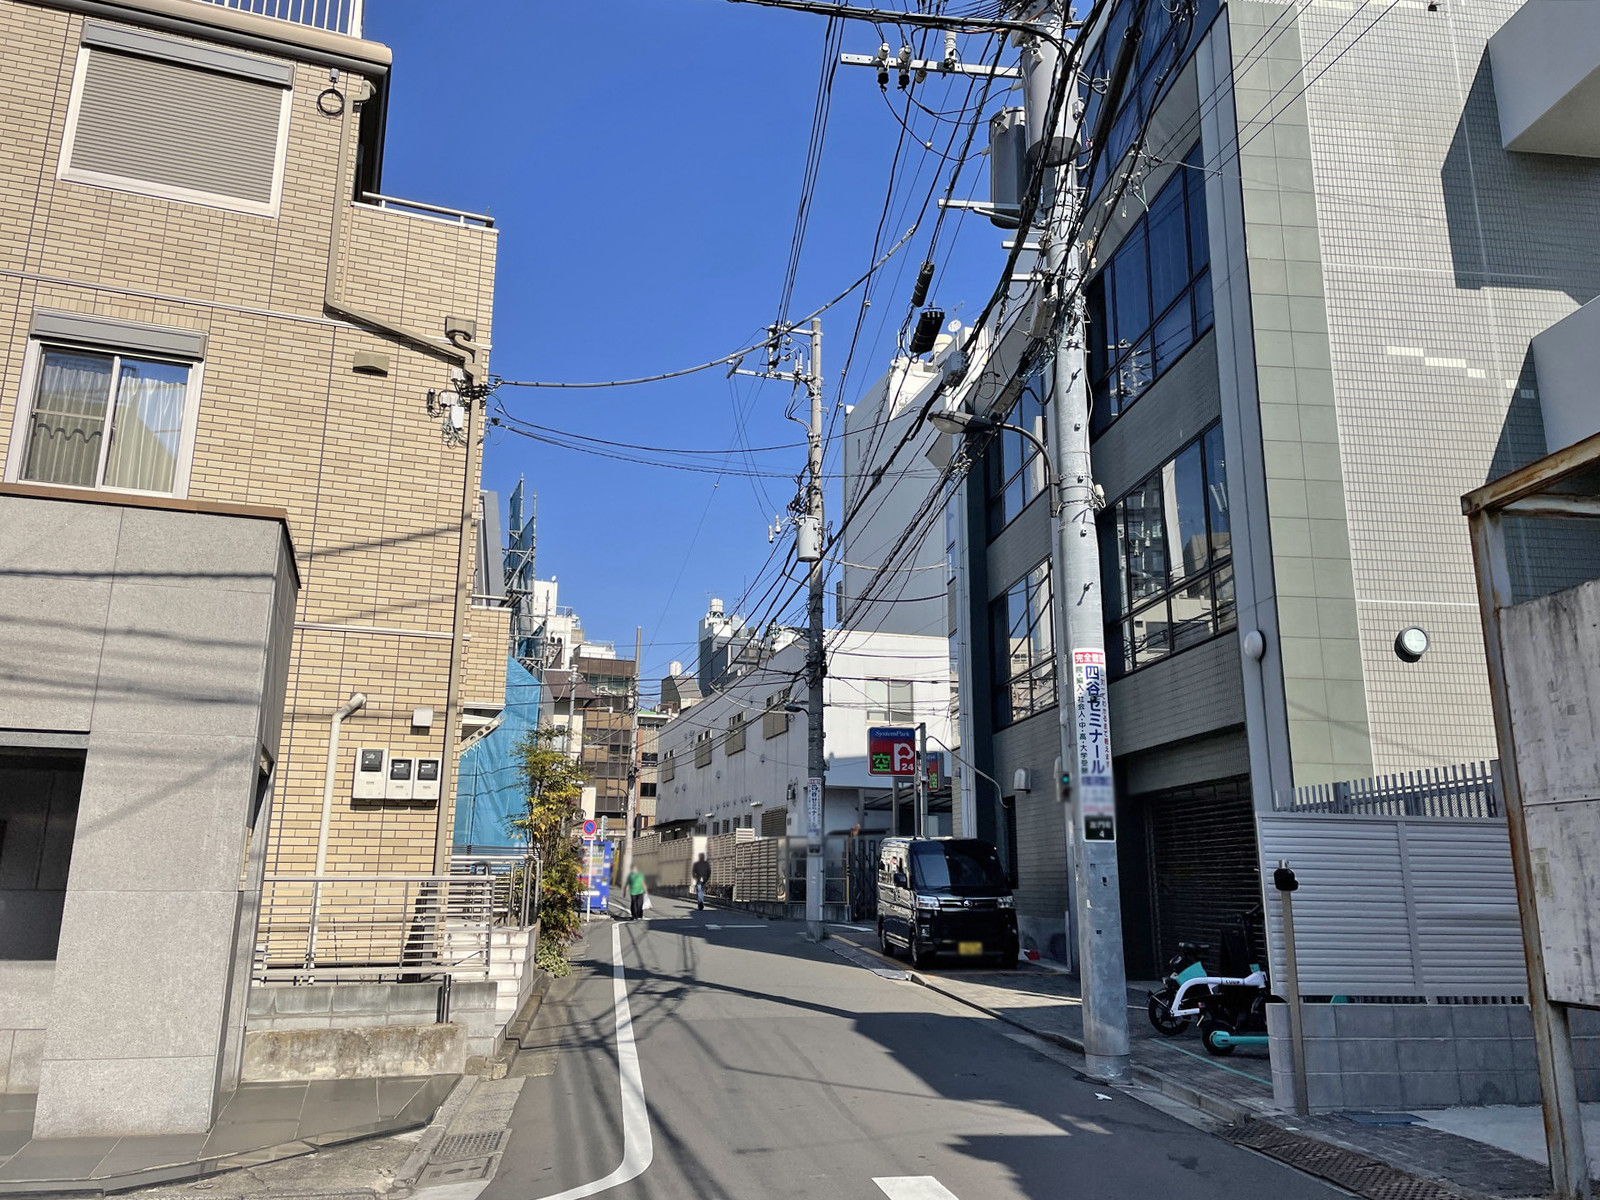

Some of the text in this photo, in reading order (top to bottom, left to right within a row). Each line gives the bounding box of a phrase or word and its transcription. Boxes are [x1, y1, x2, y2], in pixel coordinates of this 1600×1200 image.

[1085, 665, 1105, 774] 四谷セミナール
[872, 753, 891, 772] 空
[901, 763, 914, 771] 24
[1099, 830, 1105, 838] 4
